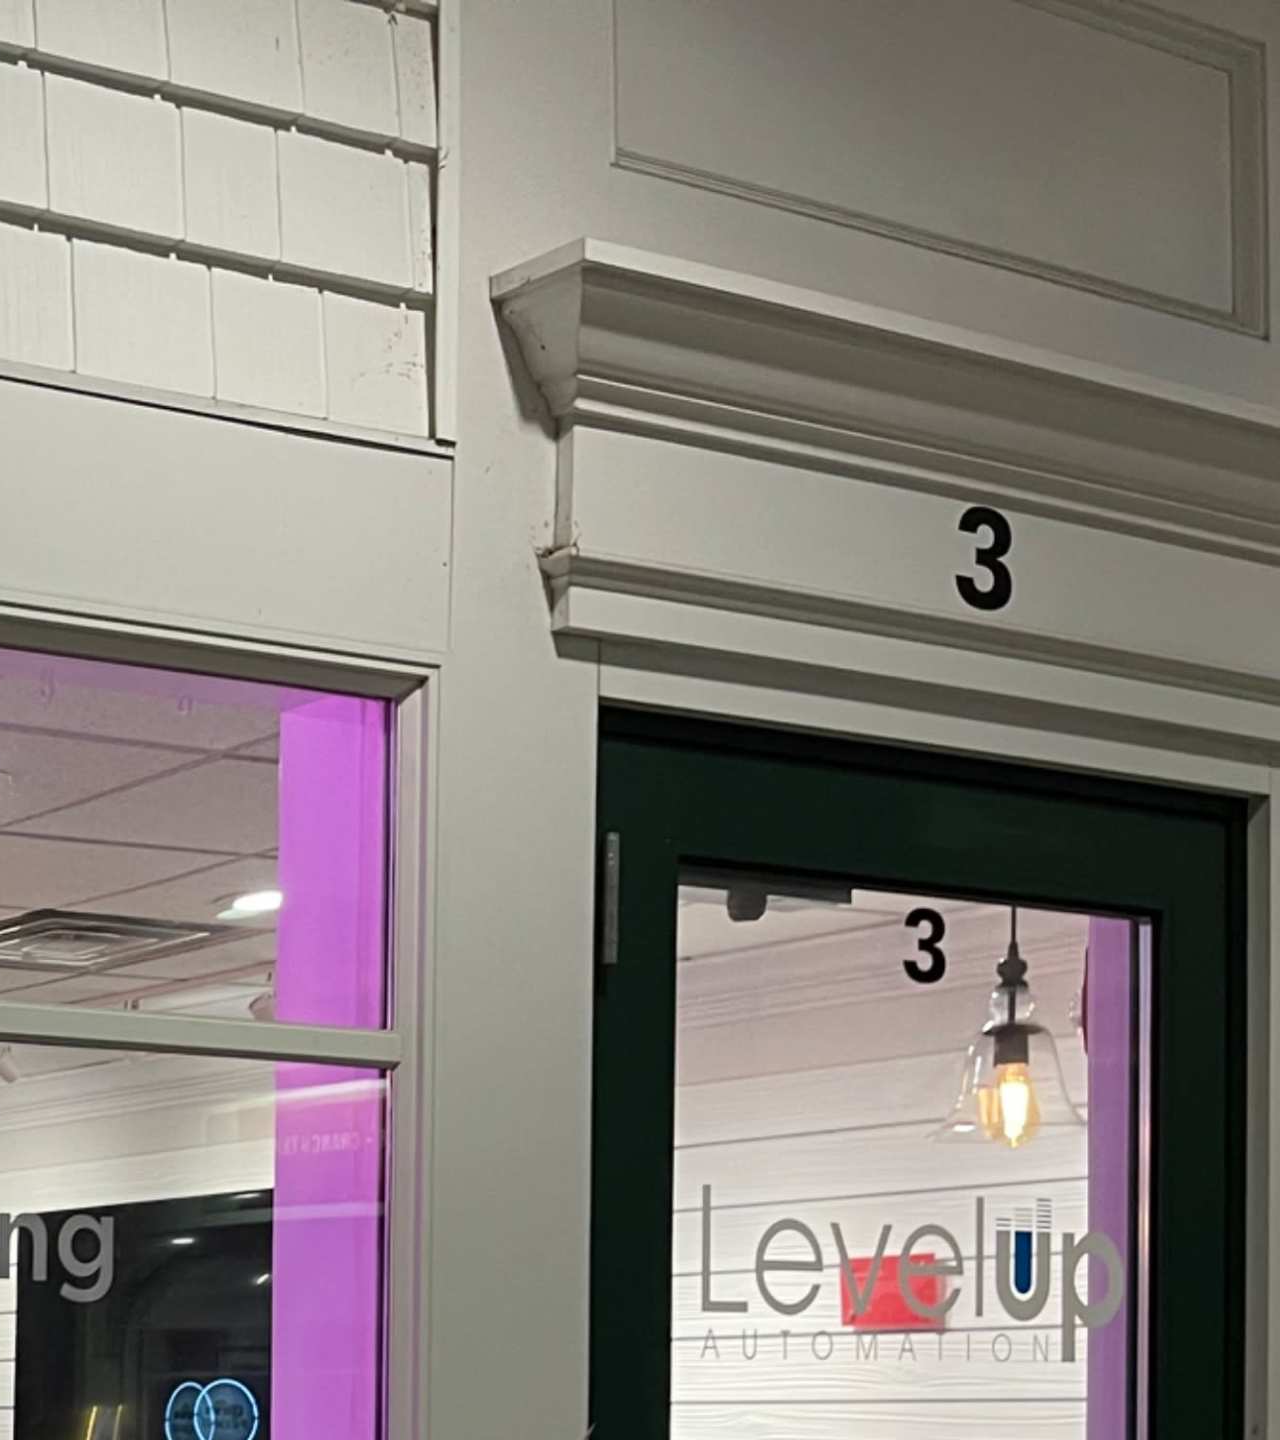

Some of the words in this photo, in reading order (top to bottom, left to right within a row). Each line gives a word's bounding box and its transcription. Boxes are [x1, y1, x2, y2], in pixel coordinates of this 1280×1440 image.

[954, 505, 1013, 612] 3
[902, 907, 947, 984] 3
[700, 1328, 1051, 1361] AUTOMATION
